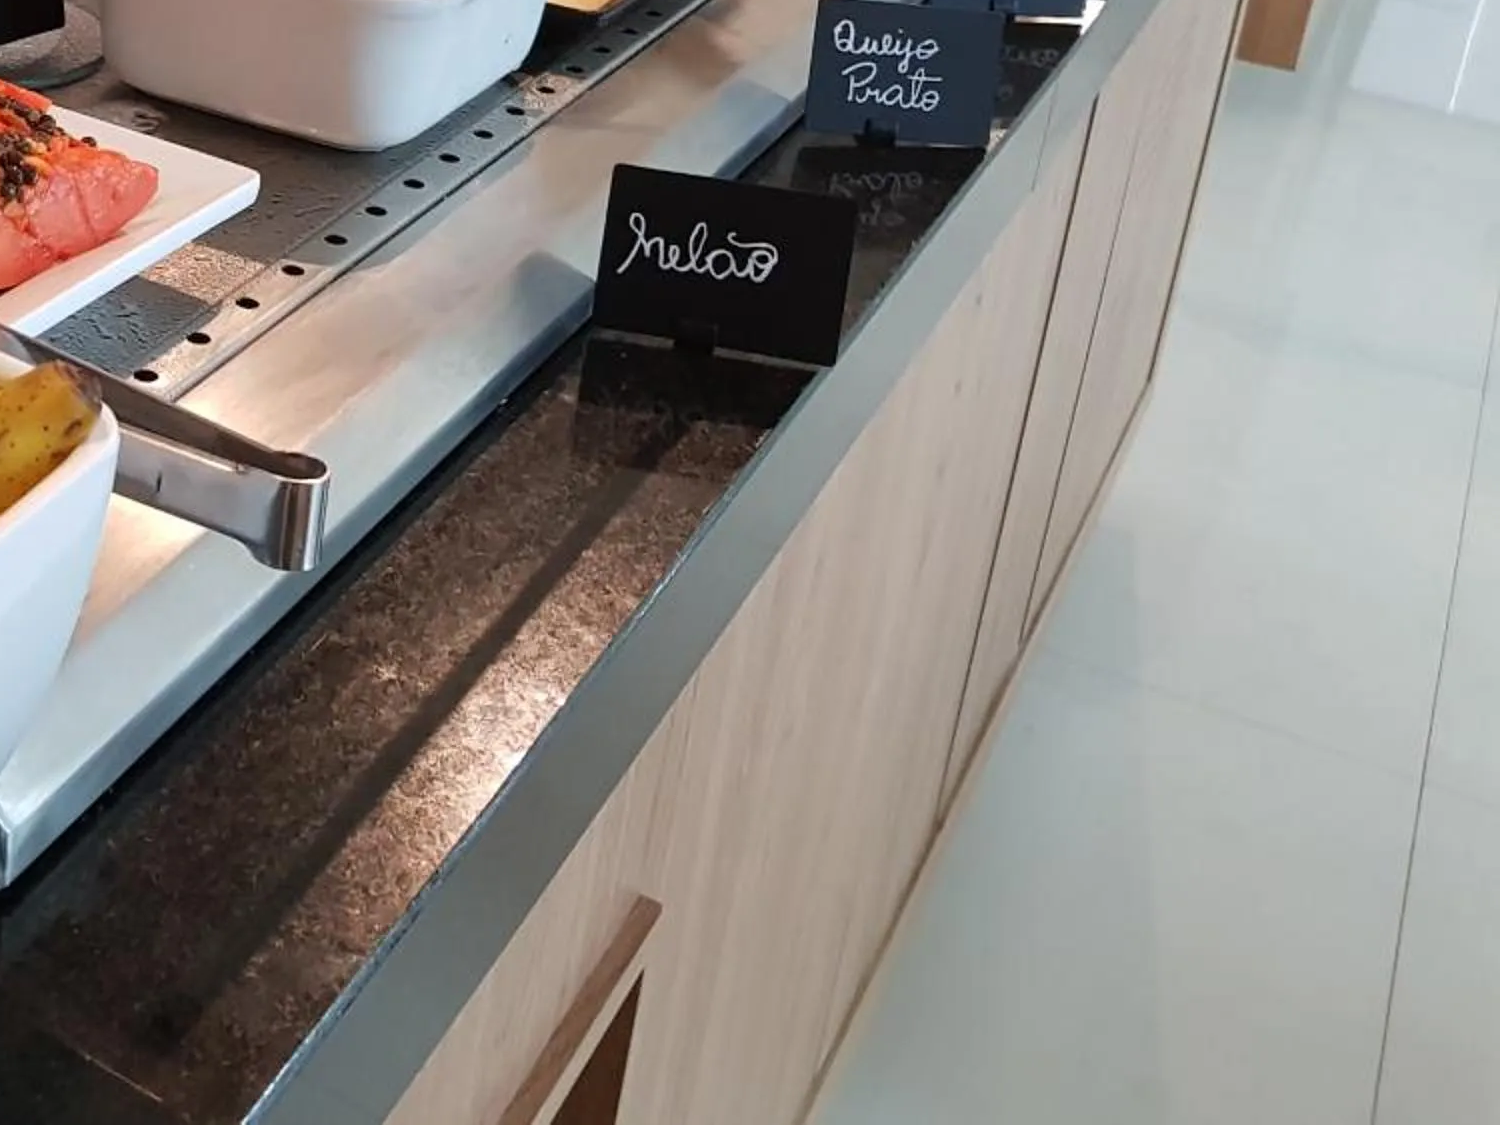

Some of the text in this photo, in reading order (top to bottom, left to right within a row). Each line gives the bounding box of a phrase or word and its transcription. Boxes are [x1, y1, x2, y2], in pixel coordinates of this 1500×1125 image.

[833, 19, 941, 73] Queijo
[841, 61, 943, 112] Prato
[617, 212, 779, 283] Melão
